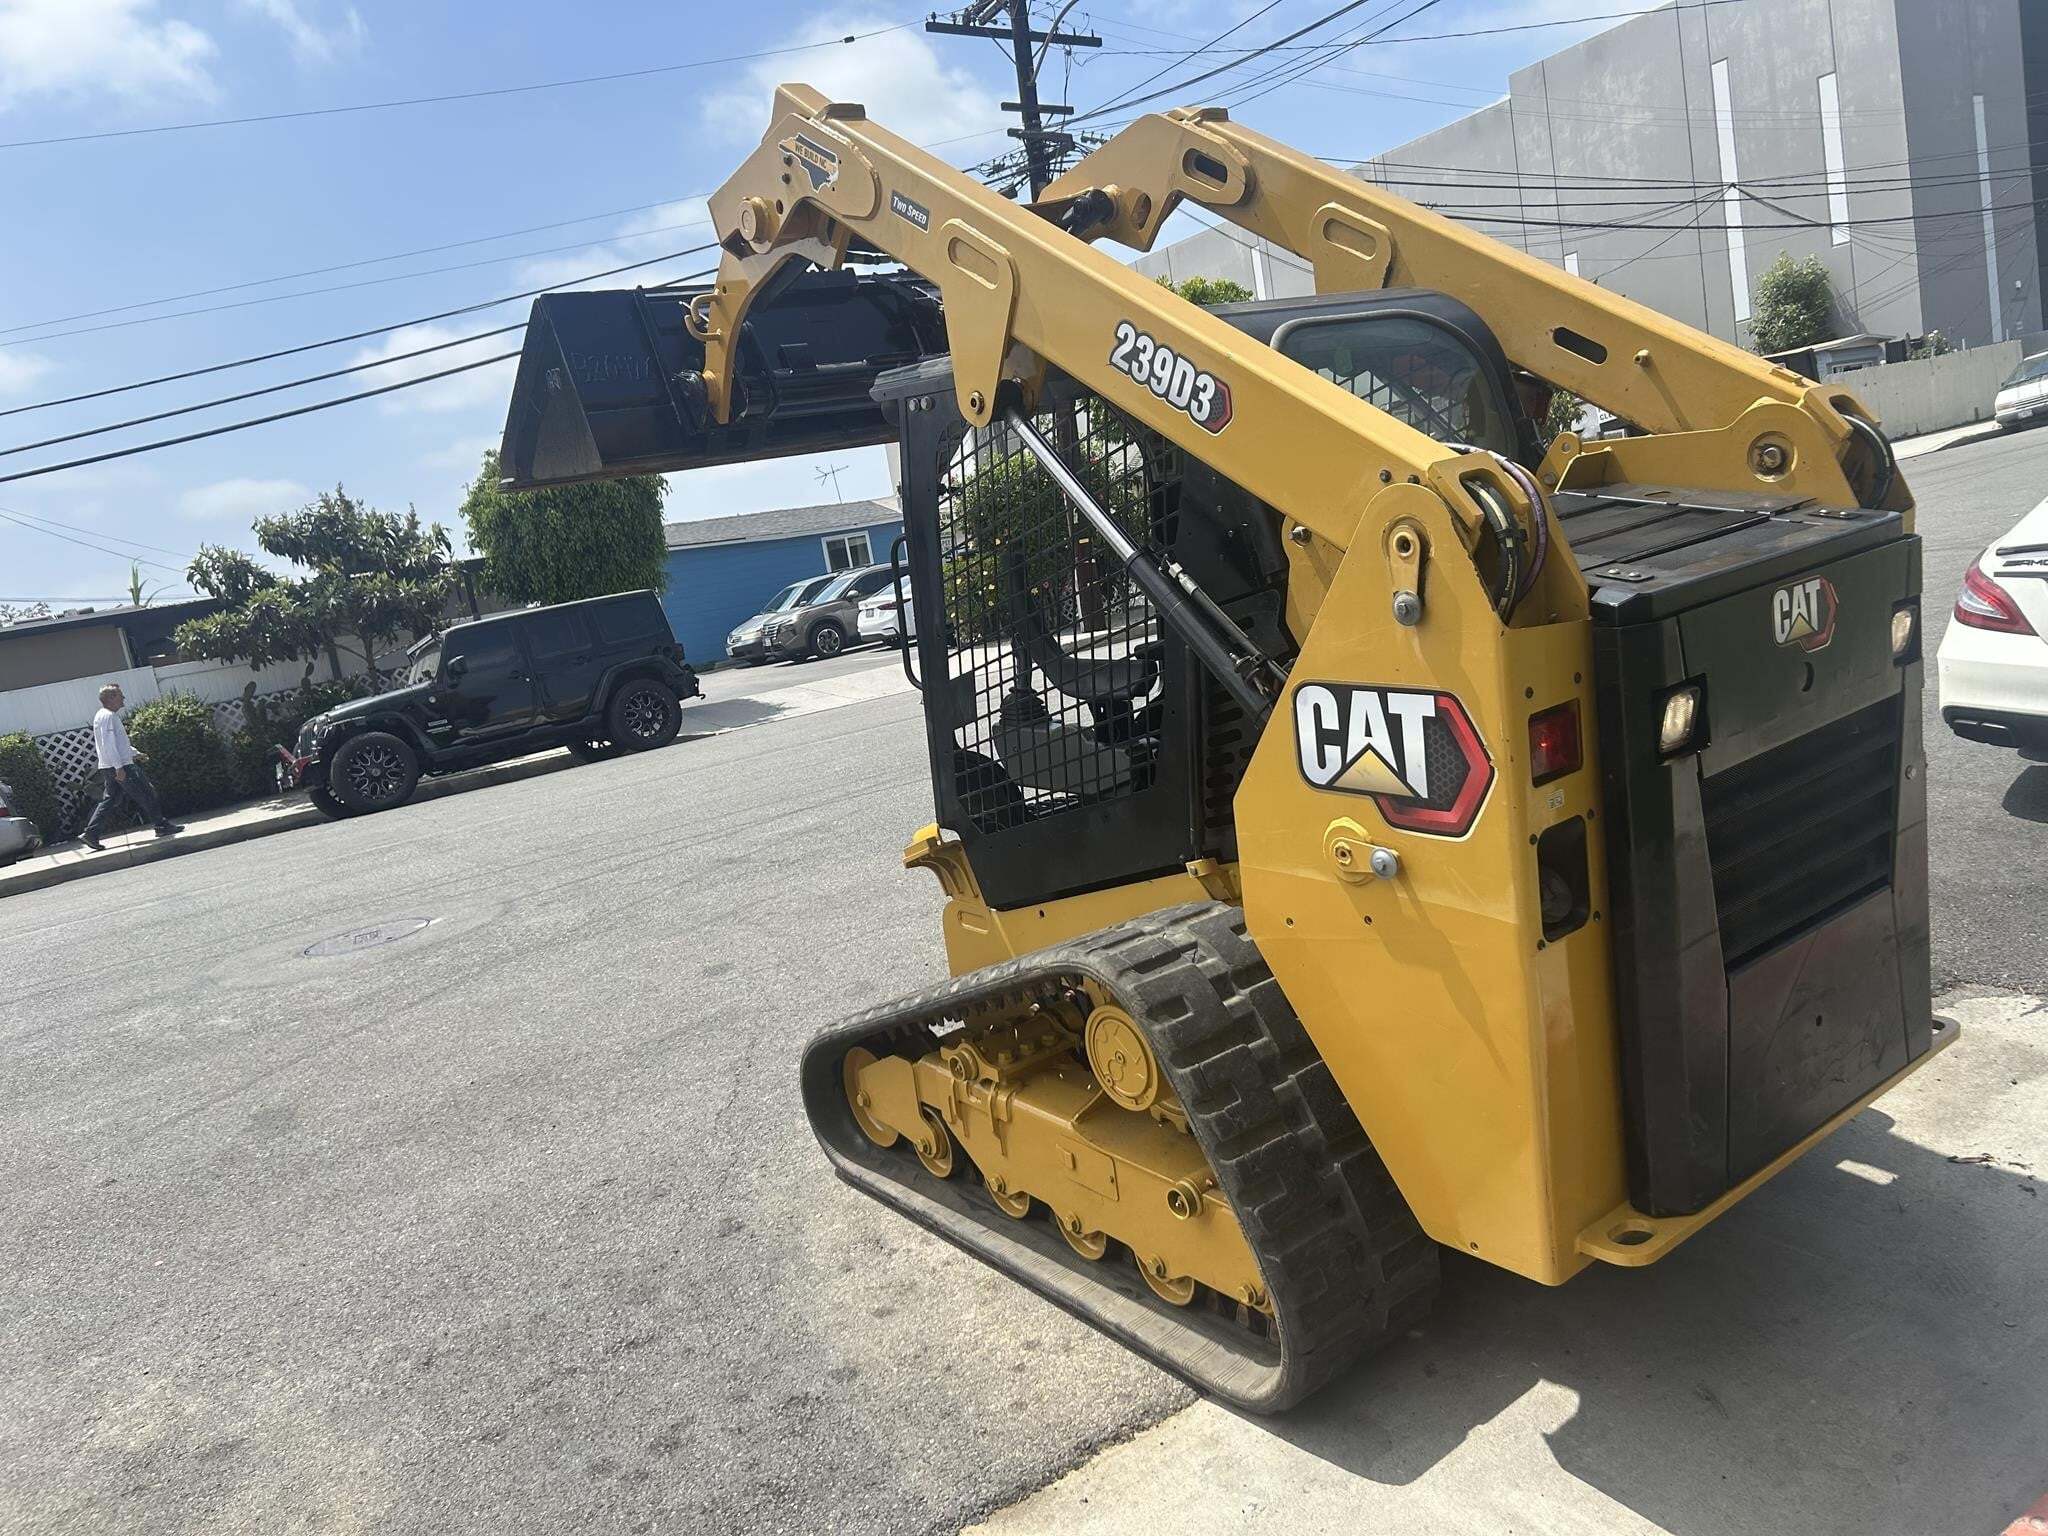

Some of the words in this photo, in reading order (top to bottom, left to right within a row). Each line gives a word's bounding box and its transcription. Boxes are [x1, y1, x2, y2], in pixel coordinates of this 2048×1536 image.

[803, 147, 819, 164] BUILD
[1110, 323, 1216, 422] 239D3
[1773, 578, 1821, 643] CAT
[1295, 685, 1436, 799] CAT
